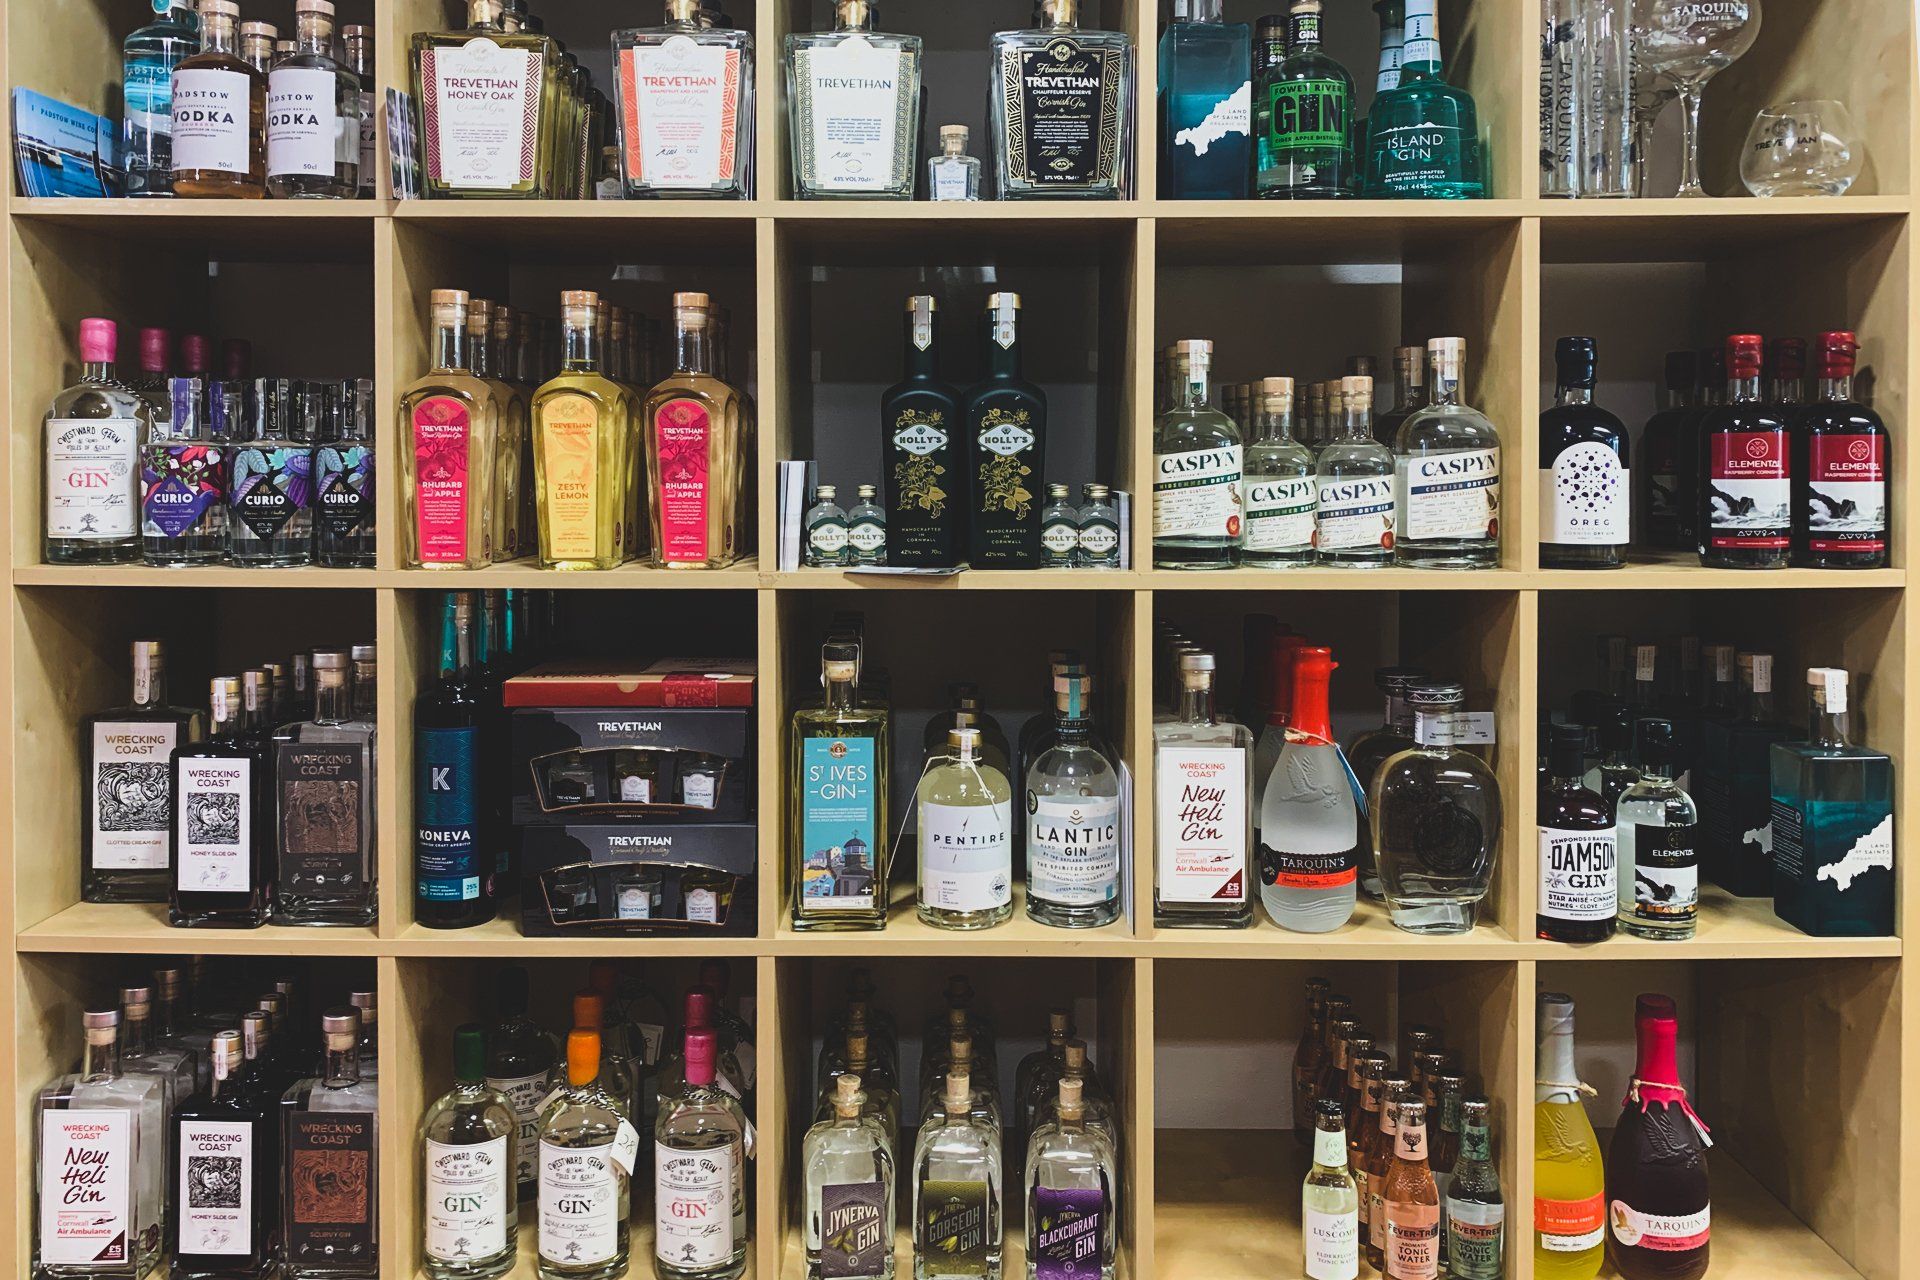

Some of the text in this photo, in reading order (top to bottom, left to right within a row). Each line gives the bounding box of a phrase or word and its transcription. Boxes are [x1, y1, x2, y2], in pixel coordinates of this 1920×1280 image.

[1299, 30, 1318, 40] GIN
[443, 77, 518, 89] TREVETHAN
[643, 76, 717, 87] TREVETHAN
[816, 78, 892, 90] TREVETHAN
[1024, 76, 1099, 88] TREVETHAN
[1274, 84, 1343, 95] FOWEY RIVER
[447, 91, 515, 101] HONEY OAK
[1037, 96, 1087, 109] Cornish Gin
[173, 111, 235, 125] VODKA
[1274, 93, 1343, 135] GIN
[1387, 133, 1444, 150] ISLAND
[1398, 148, 1432, 161] GIN
[218, 161, 233, 169] 50cl
[57, 426, 96, 445] WESTWARD
[663, 427, 704, 435] TREVETHAN
[899, 436, 943, 444] HOLLY'S
[984, 436, 1029, 444] HOLLY'S
[1161, 450, 1236, 474] CASPYN
[1421, 453, 1496, 477] CASPYN
[68, 472, 110, 488] GIN
[422, 481, 463, 489] RHUBARB
[557, 483, 586, 491] ZESTY
[665, 482, 704, 490] RHUBARB
[1320, 480, 1391, 503] CASPYN
[1425, 480, 1483, 492] CORNISH DRY
[153, 493, 194, 504] CURIO
[323, 493, 360, 504] CURIO
[434, 490, 461, 498] APPLE
[555, 492, 589, 500] LEMON
[677, 491, 702, 499] APPLE
[245, 494, 285, 506] CURIO
[1358, 507, 1374, 515] DRY
[597, 721, 662, 732] TREVETHAN
[105, 735, 166, 744] WRECKING
[115, 745, 155, 755] COAST
[290, 754, 352, 765] WRECKING
[188, 769, 241, 778] WRECKING
[300, 765, 341, 775] COAST
[830, 765, 868, 782] IVES
[196, 779, 231, 787] COAST
[432, 767, 451, 791] K
[1181, 784, 1226, 803] New
[1178, 803, 1226, 822] Heli
[419, 829, 471, 842] KONEVA
[1036, 824, 1114, 844] LANTIC
[1181, 822, 1223, 842] Gin
[608, 836, 672, 846] TREVETHAN
[933, 832, 1005, 845] PENTIRE
[1550, 836, 1587, 845] PENPONDS
[1064, 846, 1088, 857] GIN
[1551, 842, 1615, 872] DAMSON
[1083, 852, 1108, 863] DISTILLERY
[1086, 862, 1114, 871] COMPANY
[1188, 865, 1230, 873] Ambulance
[1281, 857, 1345, 870] TARQUIN'S
[1046, 872, 1074, 882] FORAGING
[1568, 874, 1607, 889] GIN
[1227, 883, 1240, 891] £5
[1548, 894, 1566, 902] STAR
[1548, 901, 1574, 909] NUTMEG
[300, 1124, 363, 1134] WRECKING
[70, 1132, 101, 1140] COAST
[190, 1133, 242, 1143] WRECKING
[310, 1135, 352, 1145] COAST
[198, 1143, 233, 1152] COAST
[64, 1147, 110, 1166] New
[434, 1152, 471, 1169] WESTWARD
[547, 1156, 583, 1171] WESTWARD
[662, 1158, 696, 1173] WESTWARD
[61, 1165, 109, 1185] Heli
[63, 1185, 106, 1205] Gin
[444, 1195, 483, 1213] GIN
[558, 1199, 592, 1214] GIN
[671, 1202, 708, 1218] GIN
[826, 1206, 880, 1237] JYNERVA
[857, 1222, 881, 1251] GIN
[1039, 1213, 1099, 1249] BLACKCURRANT
[960, 1228, 980, 1252] GIN
[108, 1245, 122, 1253] £5
[1075, 1234, 1096, 1259] GIN
[1399, 1246, 1430, 1255] TONIC
[1459, 1243, 1491, 1255] TONIC
[1397, 1254, 1430, 1263] WATER
[1458, 1251, 1492, 1262] WATER
